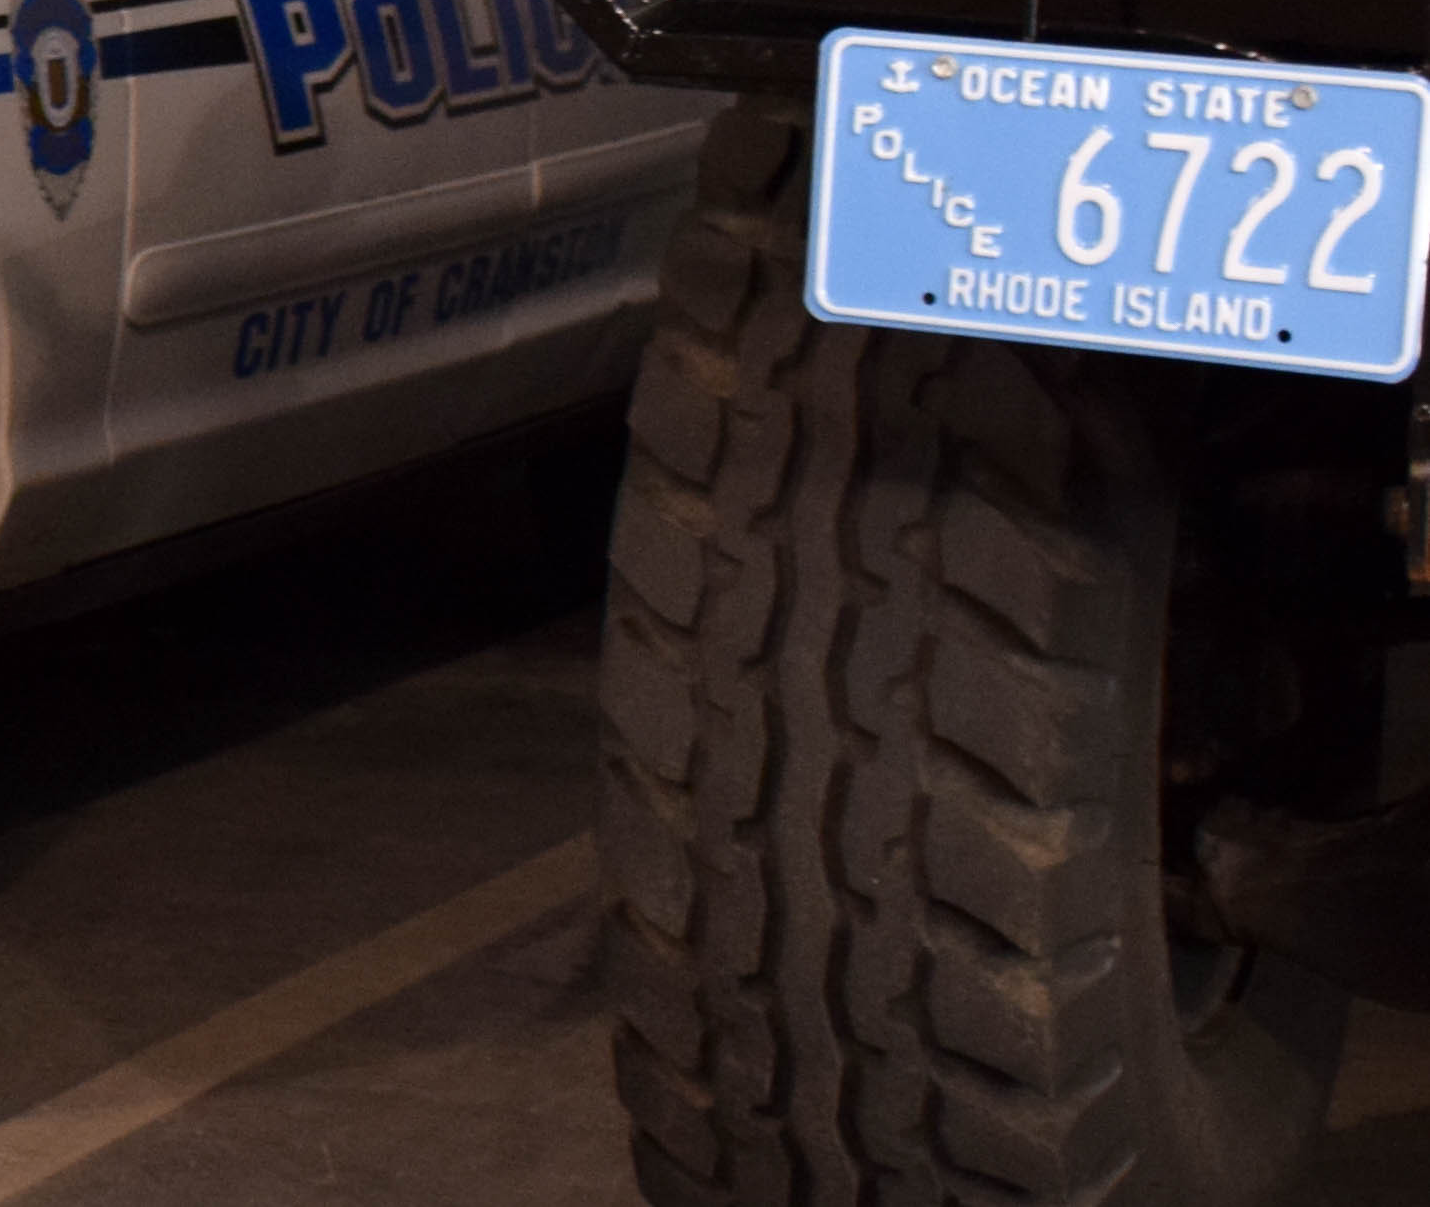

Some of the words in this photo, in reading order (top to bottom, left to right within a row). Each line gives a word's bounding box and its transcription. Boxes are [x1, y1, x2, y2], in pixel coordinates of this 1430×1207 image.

[961, 66, 1111, 111] OCEAN
[1146, 81, 1291, 129] STATE
[853, 103, 1003, 259] POLICE
[1056, 125, 1384, 295] 6722
[233, 291, 347, 379] CITY
[363, 273, 420, 343] OF
[948, 267, 1090, 322] RHODE
[1113, 285, 1274, 342] ISLAND
